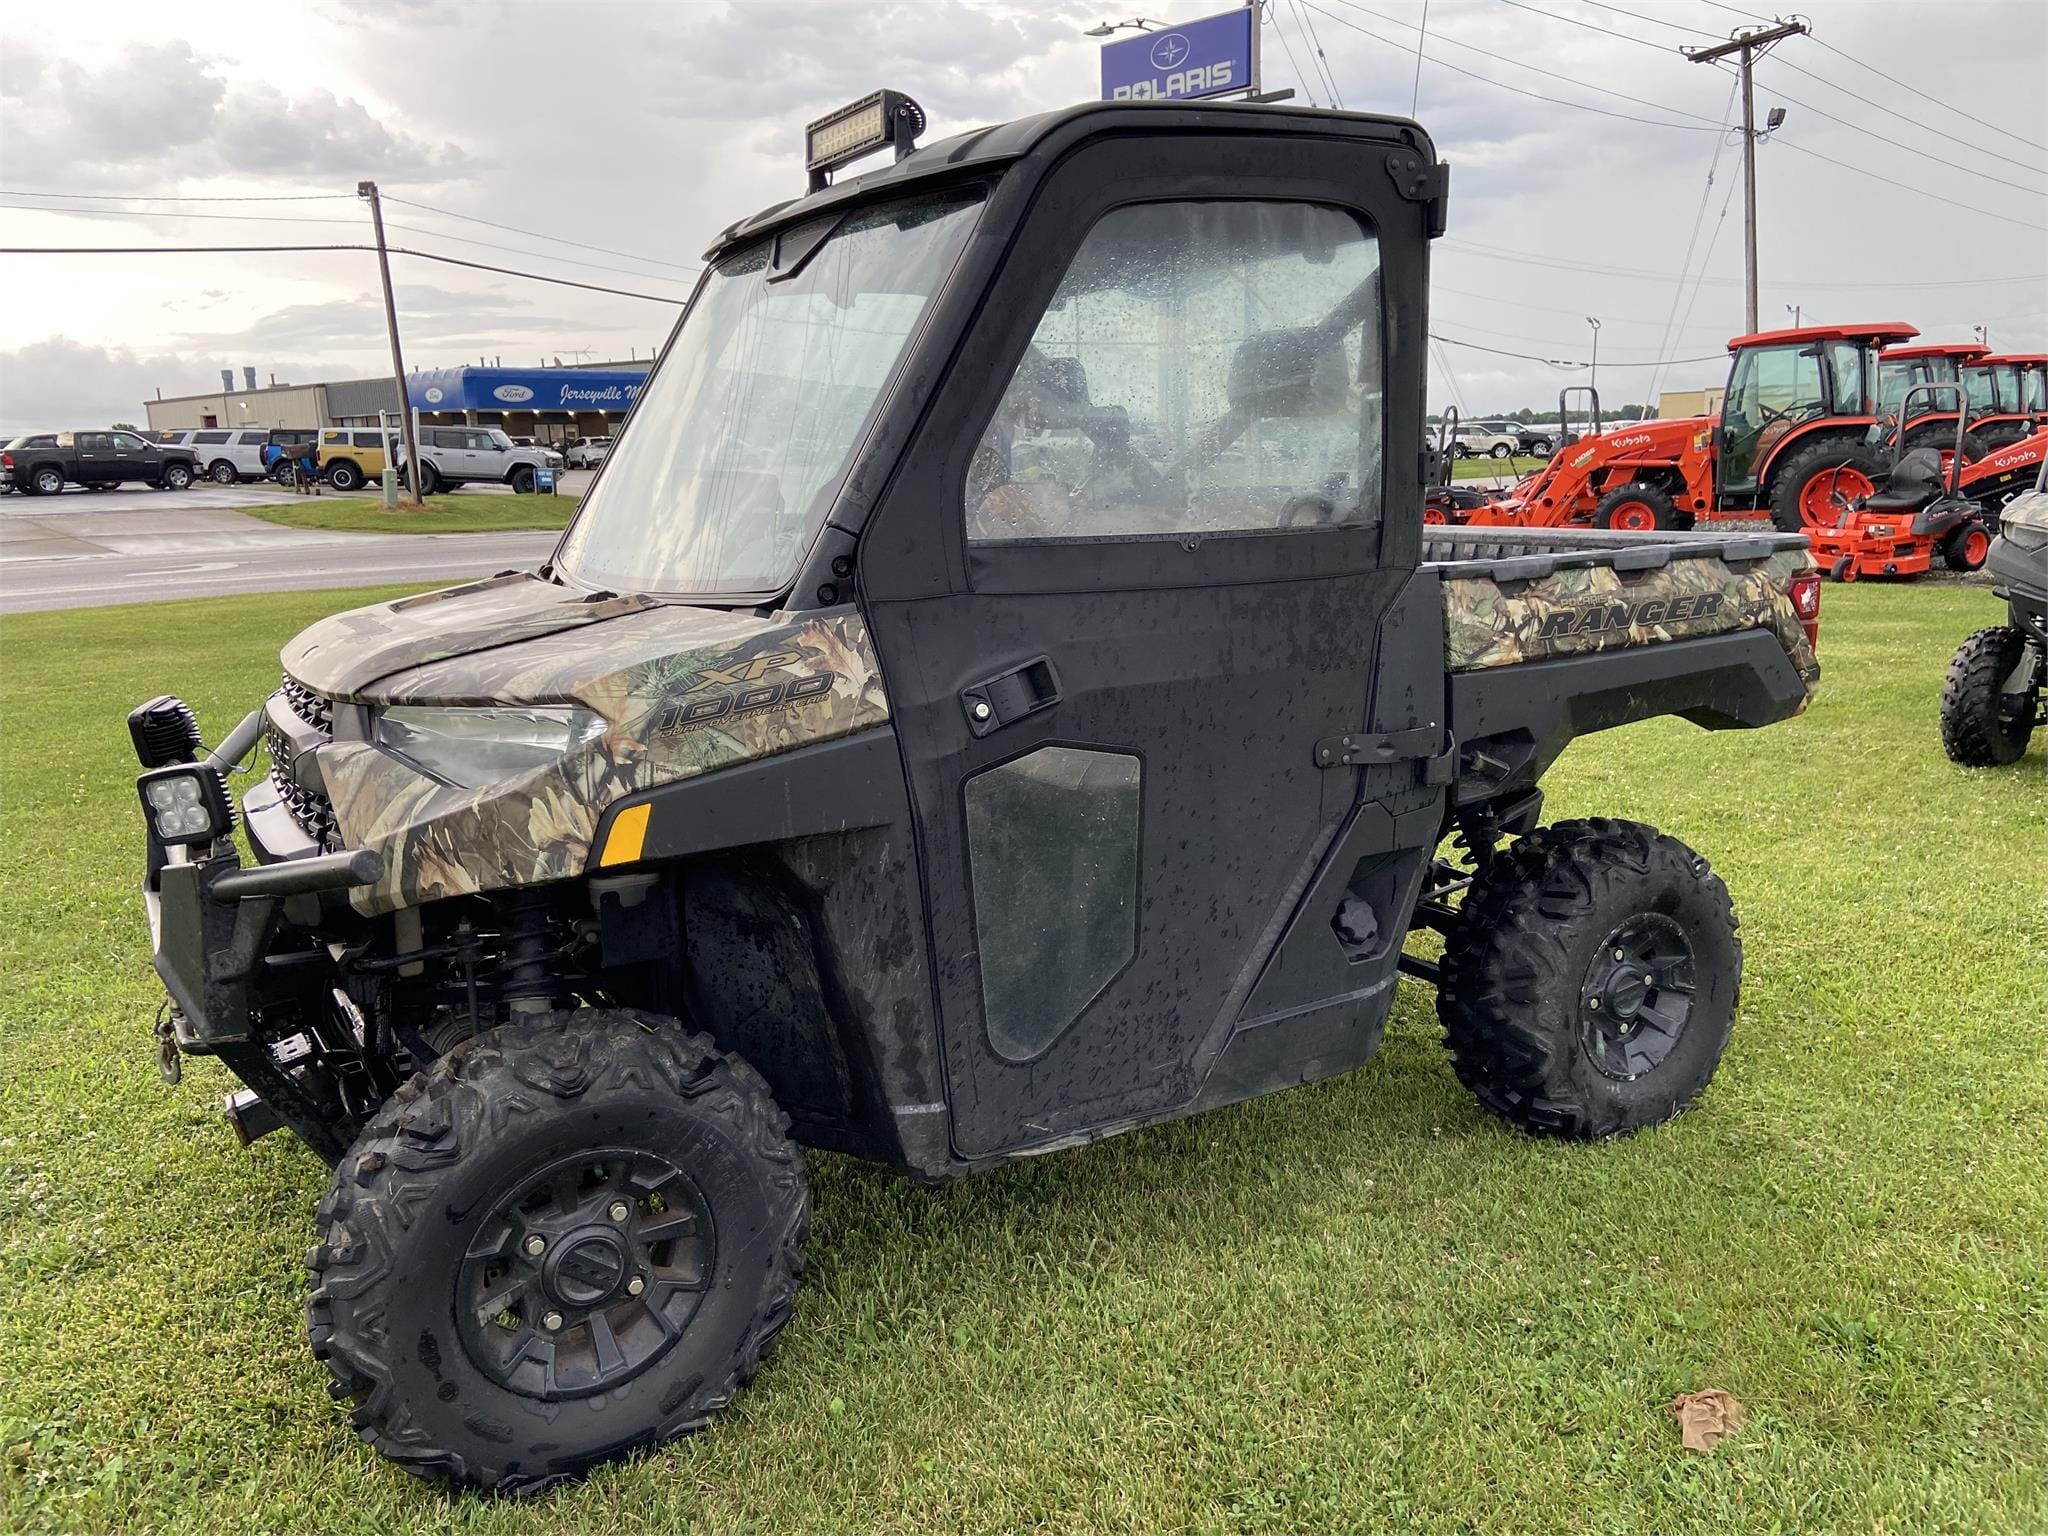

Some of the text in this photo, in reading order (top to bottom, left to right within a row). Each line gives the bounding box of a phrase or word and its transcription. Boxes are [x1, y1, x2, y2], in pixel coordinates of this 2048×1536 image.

[1113, 60, 1232, 100] POLARIS
[560, 384, 622, 405] Jerseyville
[1611, 434, 1652, 448] Kubota
[1994, 451, 2037, 467] Kubota
[1537, 591, 1724, 639] RANGER
[1560, 594, 1608, 608] POLARIS
[678, 650, 804, 695] XP
[659, 671, 837, 730] 1000
[660, 694, 830, 738] DUAL OVERHEAD CAM
